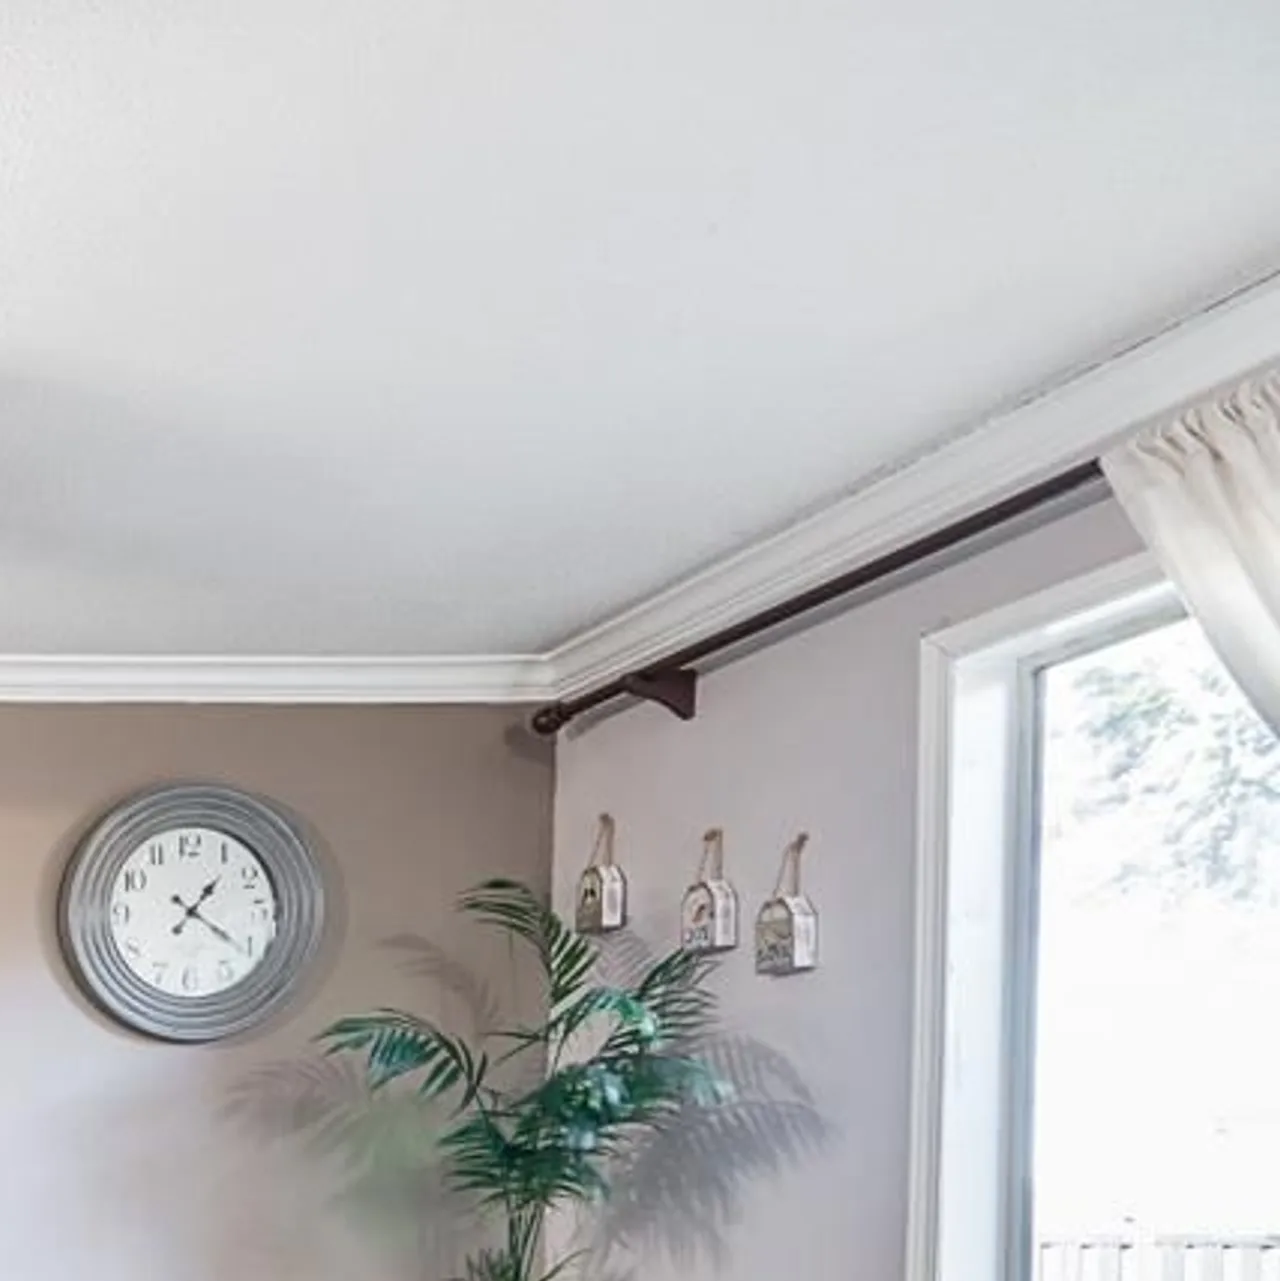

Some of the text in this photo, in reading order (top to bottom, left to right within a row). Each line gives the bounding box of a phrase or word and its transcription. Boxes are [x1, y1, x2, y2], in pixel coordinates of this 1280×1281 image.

[149, 843, 164, 865] 11
[178, 834, 202, 858] 12
[220, 842, 229, 864] 1
[124, 870, 148, 892] 10
[241, 867, 258, 889] 2
[113, 903, 130, 923] 9
[153, 961, 169, 984] 7
[181, 966, 199, 990] 6
